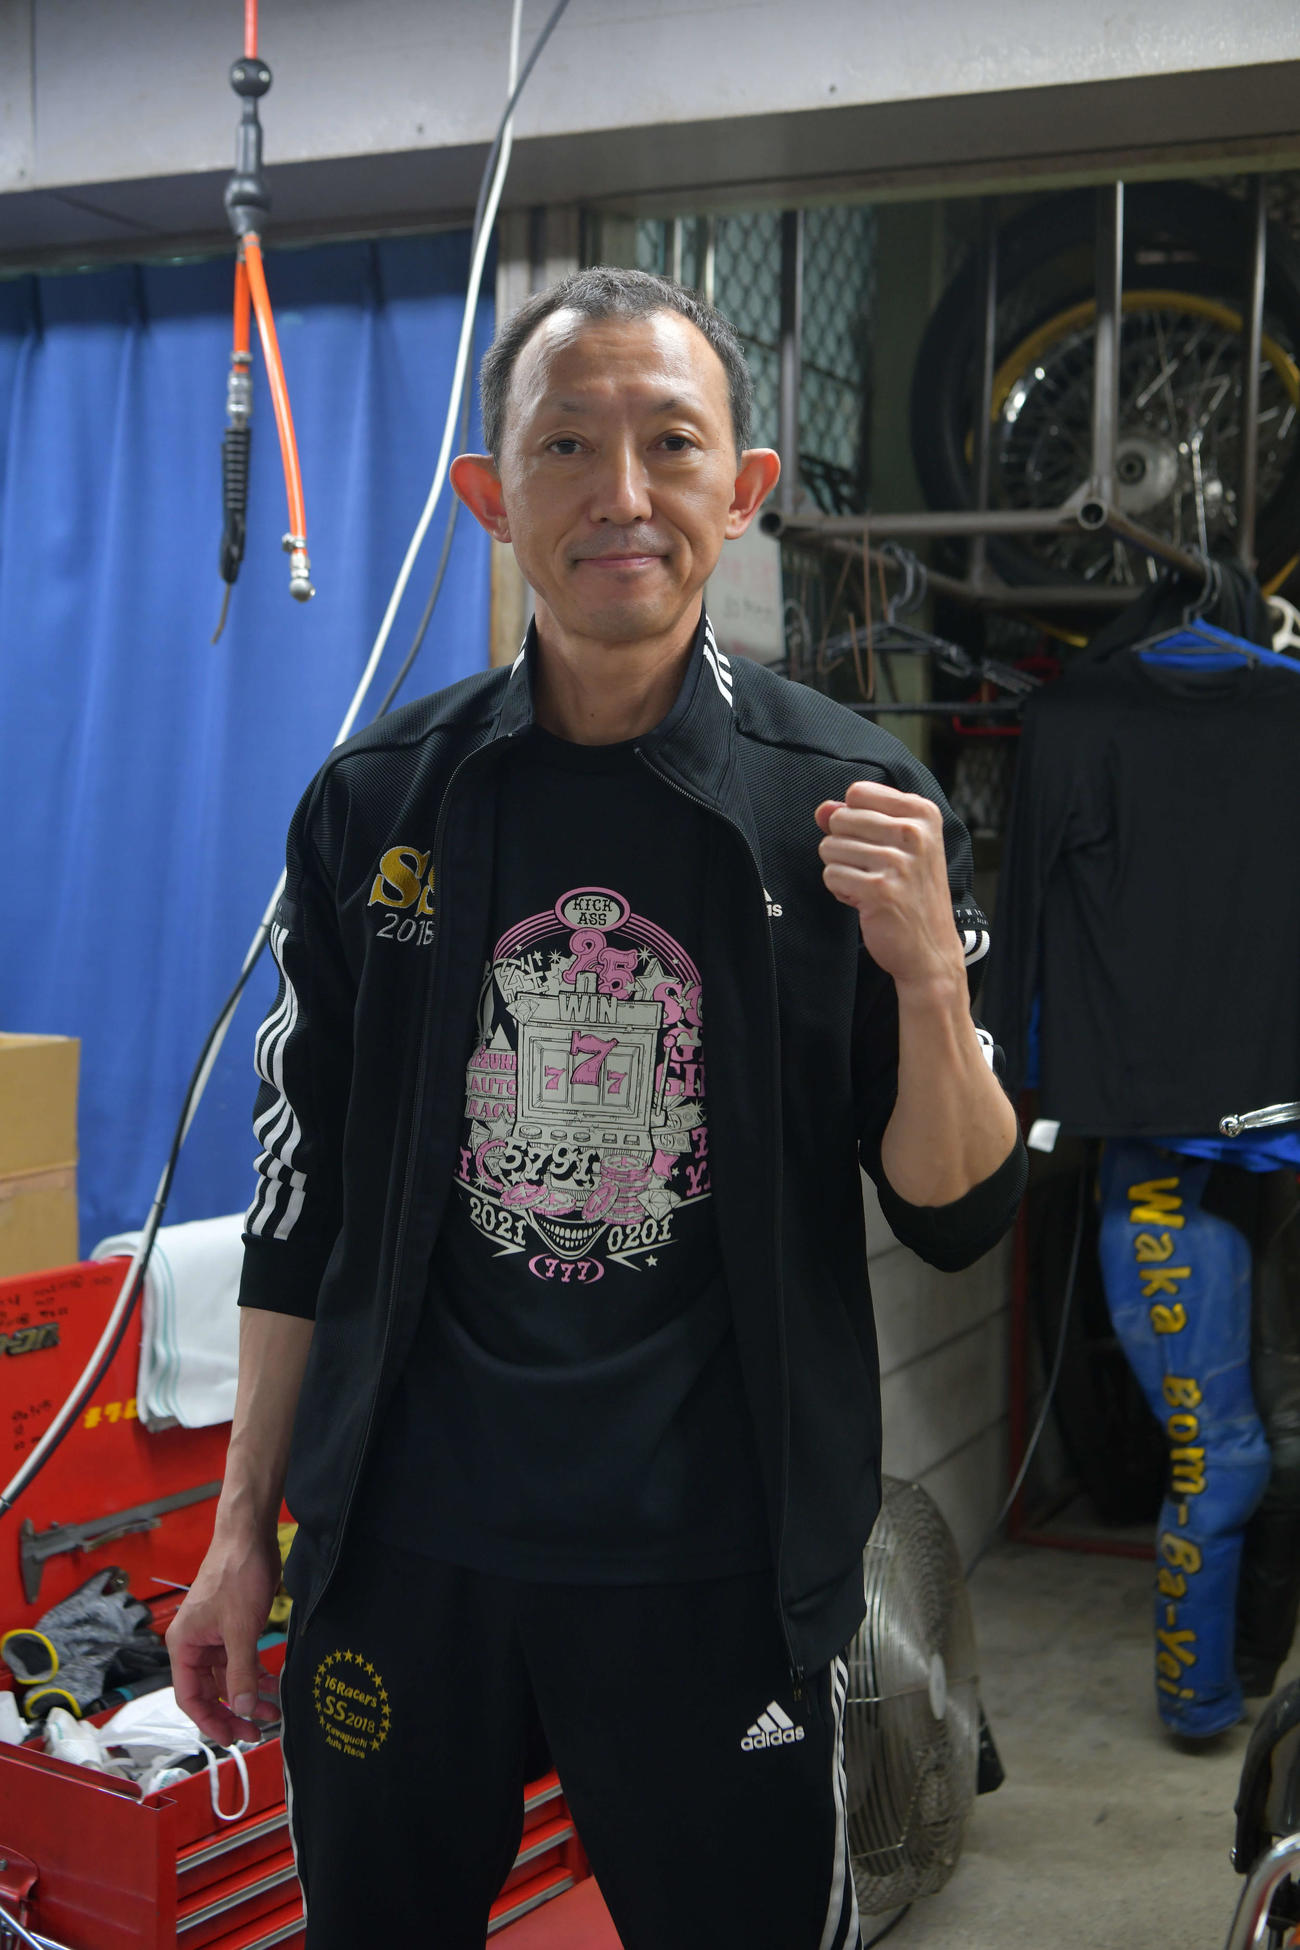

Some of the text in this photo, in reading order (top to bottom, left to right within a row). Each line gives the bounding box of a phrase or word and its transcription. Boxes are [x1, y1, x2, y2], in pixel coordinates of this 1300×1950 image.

[572, 898, 613, 912] KICK
[577, 912, 607, 927] ASS
[559, 994, 619, 1025] WIN
[544, 1030, 628, 1094] 7 7 7
[499, 1136, 600, 1182] 5791
[469, 1198, 528, 1247] 2021
[607, 1213, 674, 1252] 0201
[1127, 1177, 1191, 1335] Waka
[741, 1725, 805, 1752] adidas
